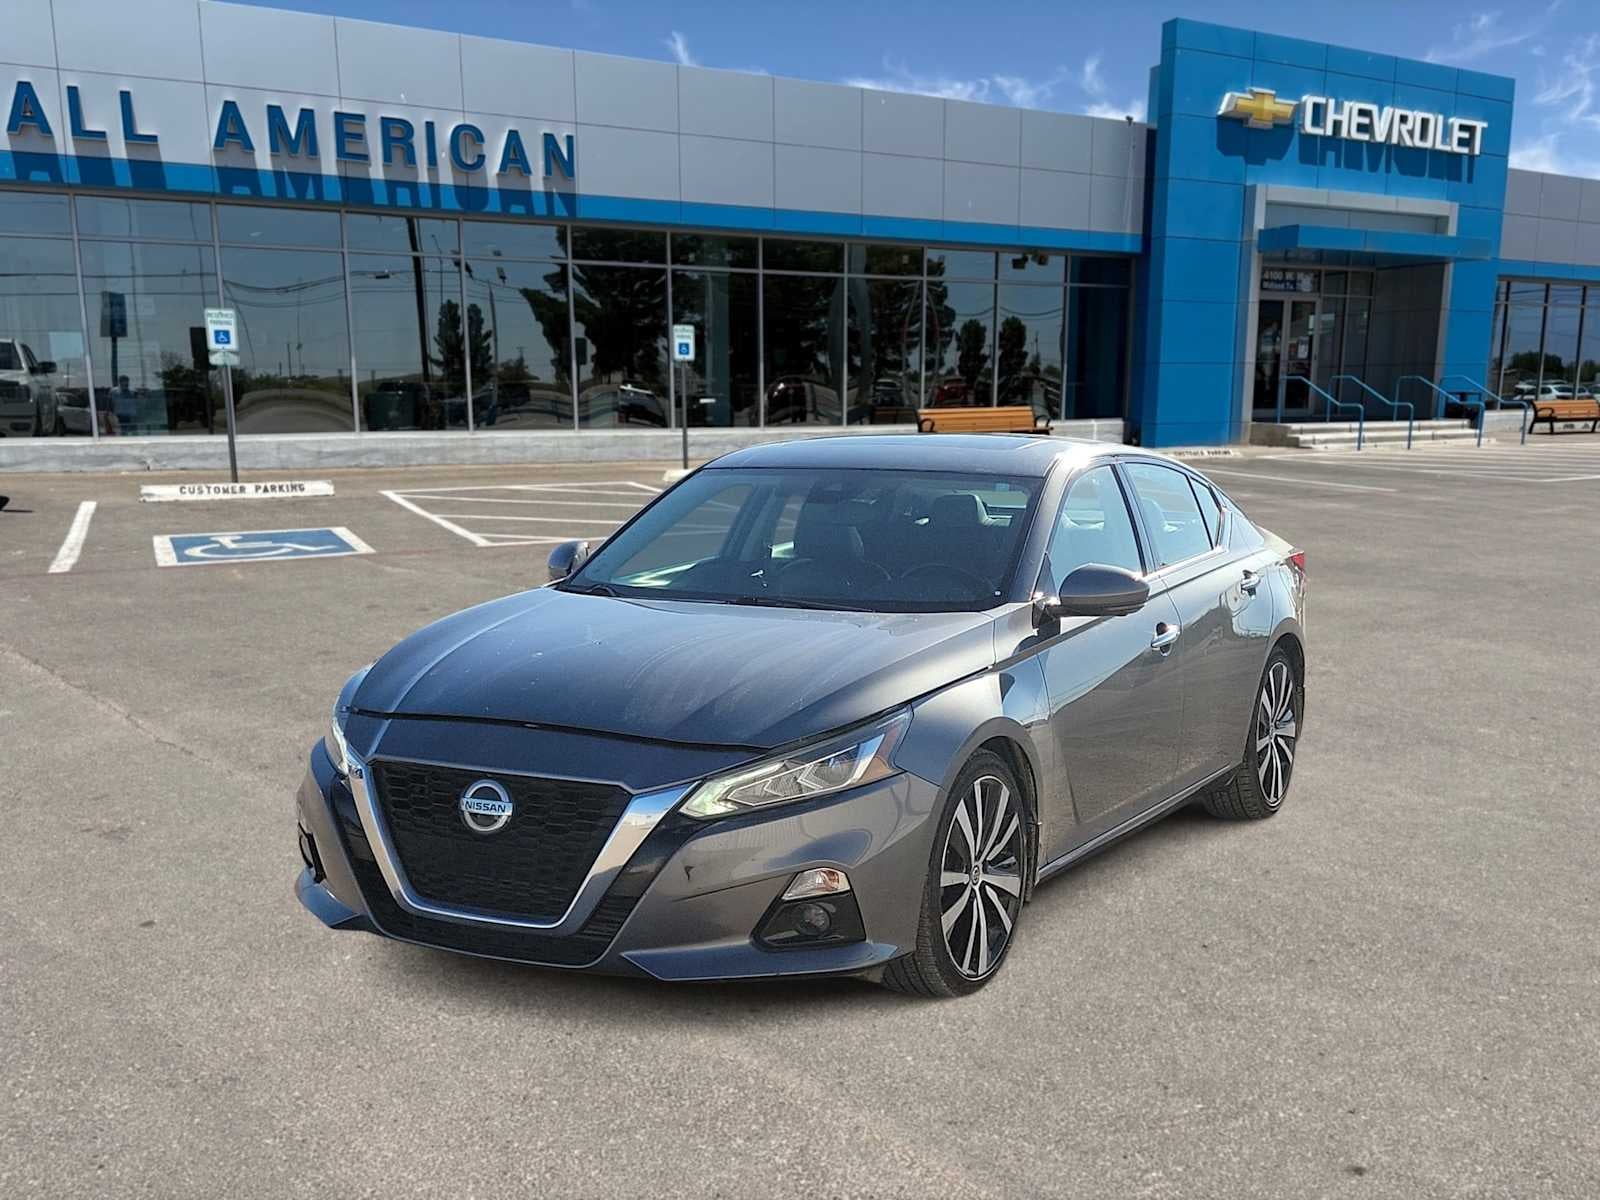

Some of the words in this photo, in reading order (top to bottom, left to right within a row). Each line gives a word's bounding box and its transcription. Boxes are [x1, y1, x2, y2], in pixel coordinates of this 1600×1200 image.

[7, 80, 158, 143] ALL
[213, 100, 575, 179] AMERICAN
[1302, 93, 1488, 155] CHEVROLET
[179, 485, 246, 496] CUSTOMER
[254, 483, 305, 494] PARKING
[465, 801, 506, 813] NISSAN
